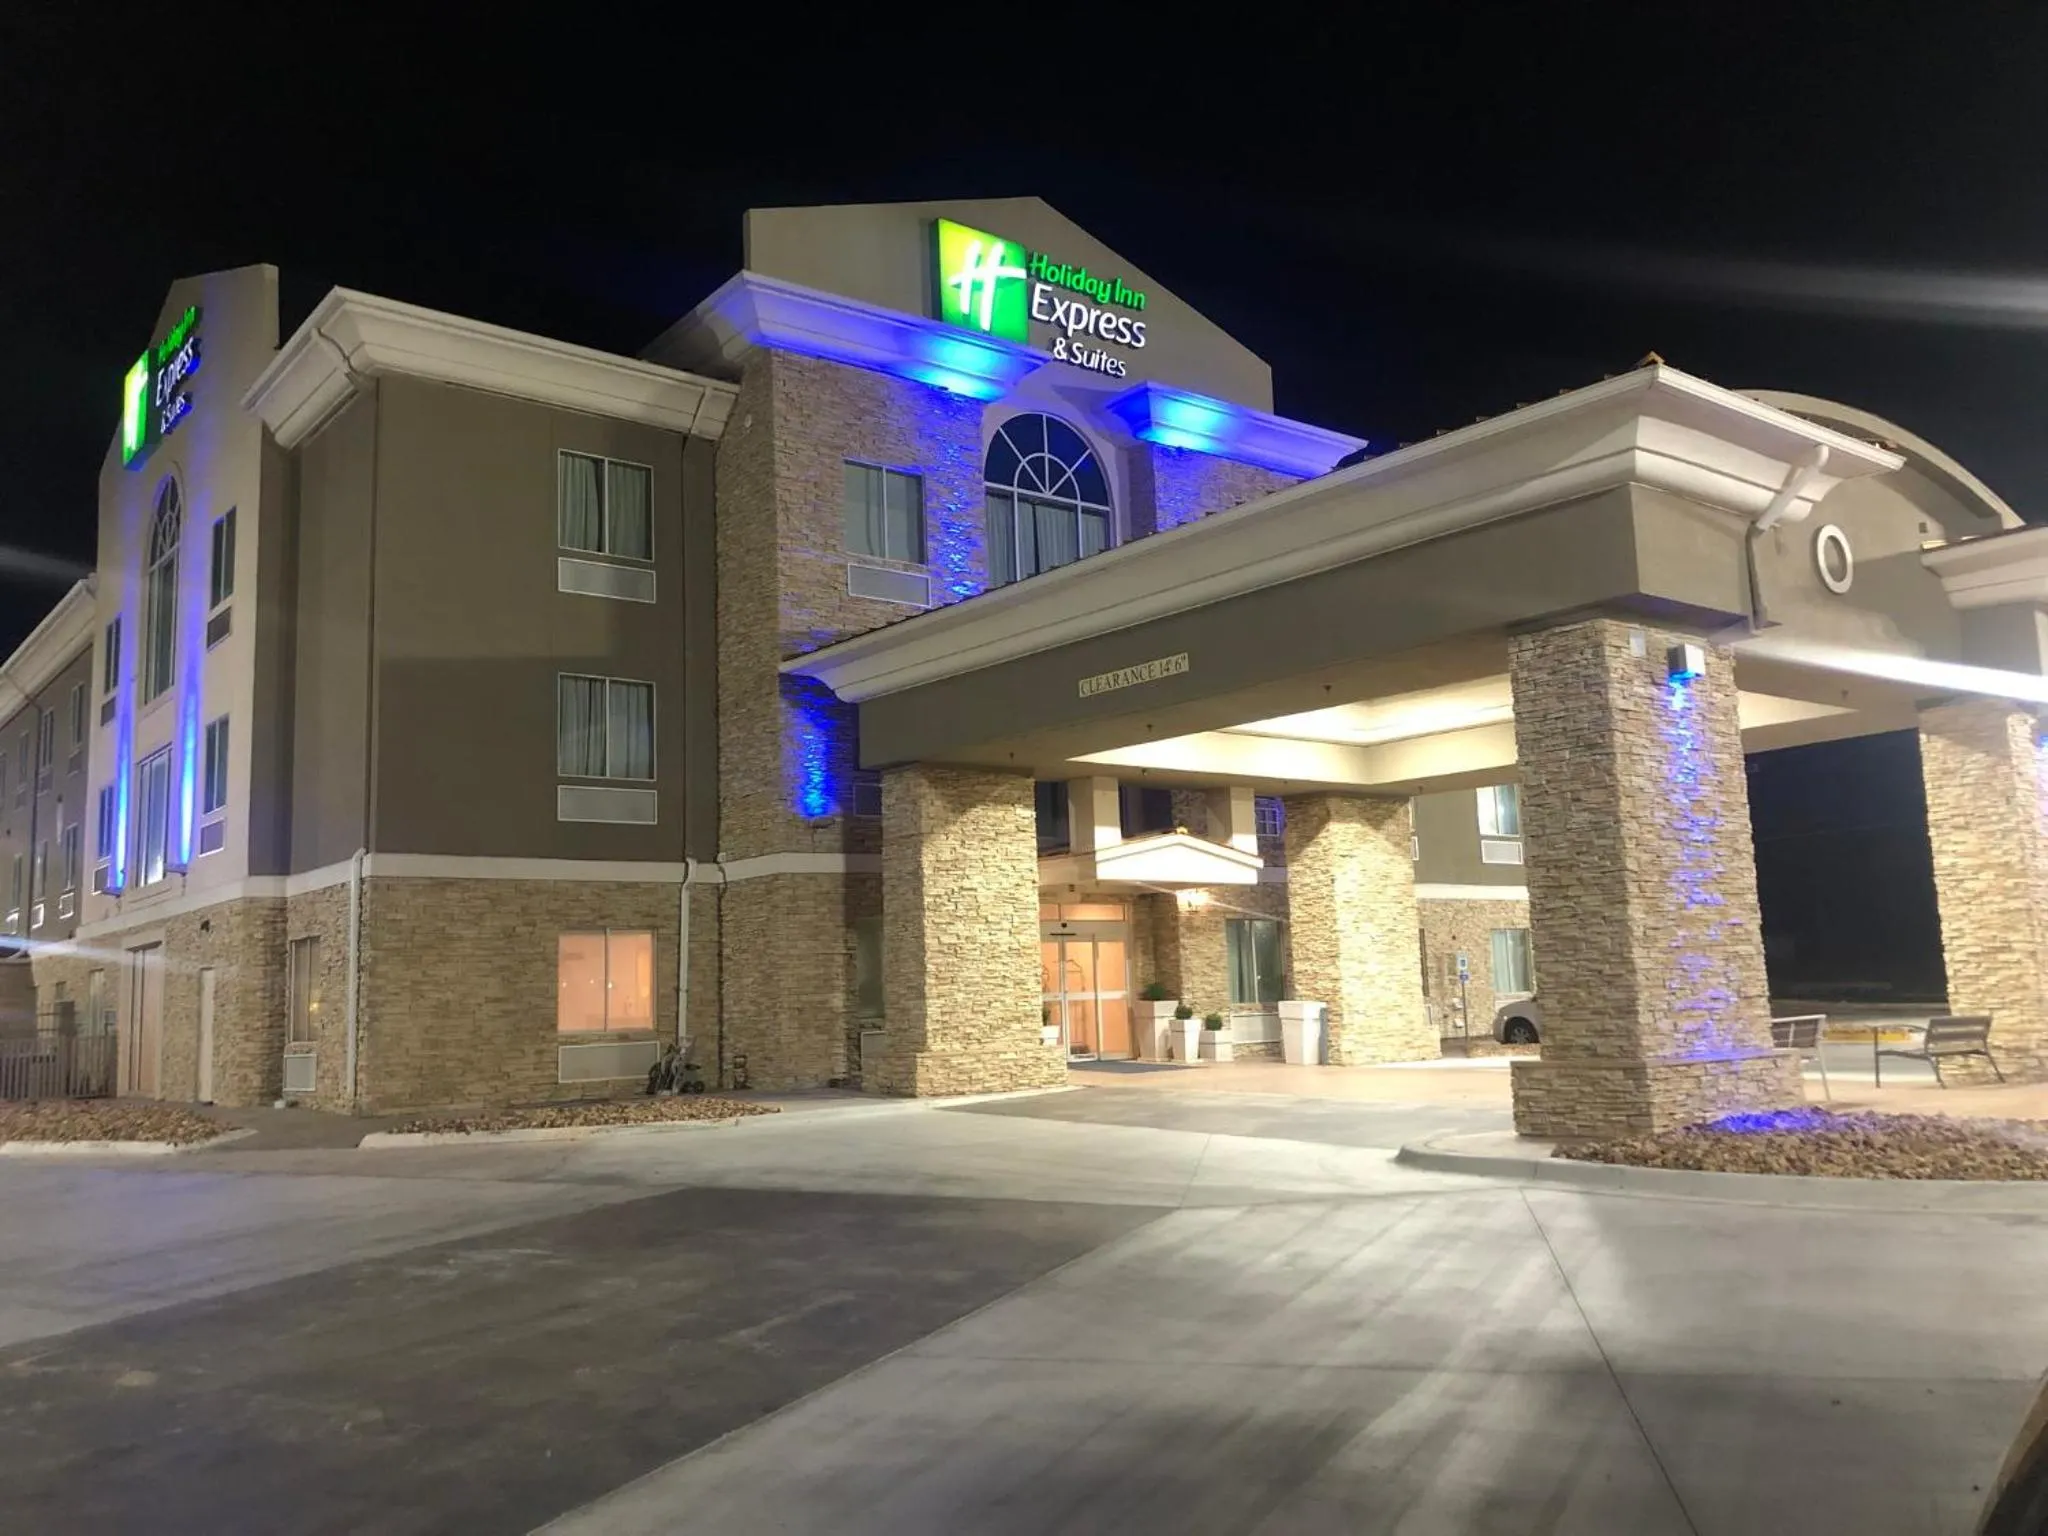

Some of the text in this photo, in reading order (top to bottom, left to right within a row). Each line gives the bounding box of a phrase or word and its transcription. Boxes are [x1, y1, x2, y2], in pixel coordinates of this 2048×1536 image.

[1029, 251, 1146, 310] Holiday Inn
[1031, 282, 1147, 348] Express
[1053, 337, 1126, 376] & Suites
[1081, 663, 1157, 696] CLEARANCE
